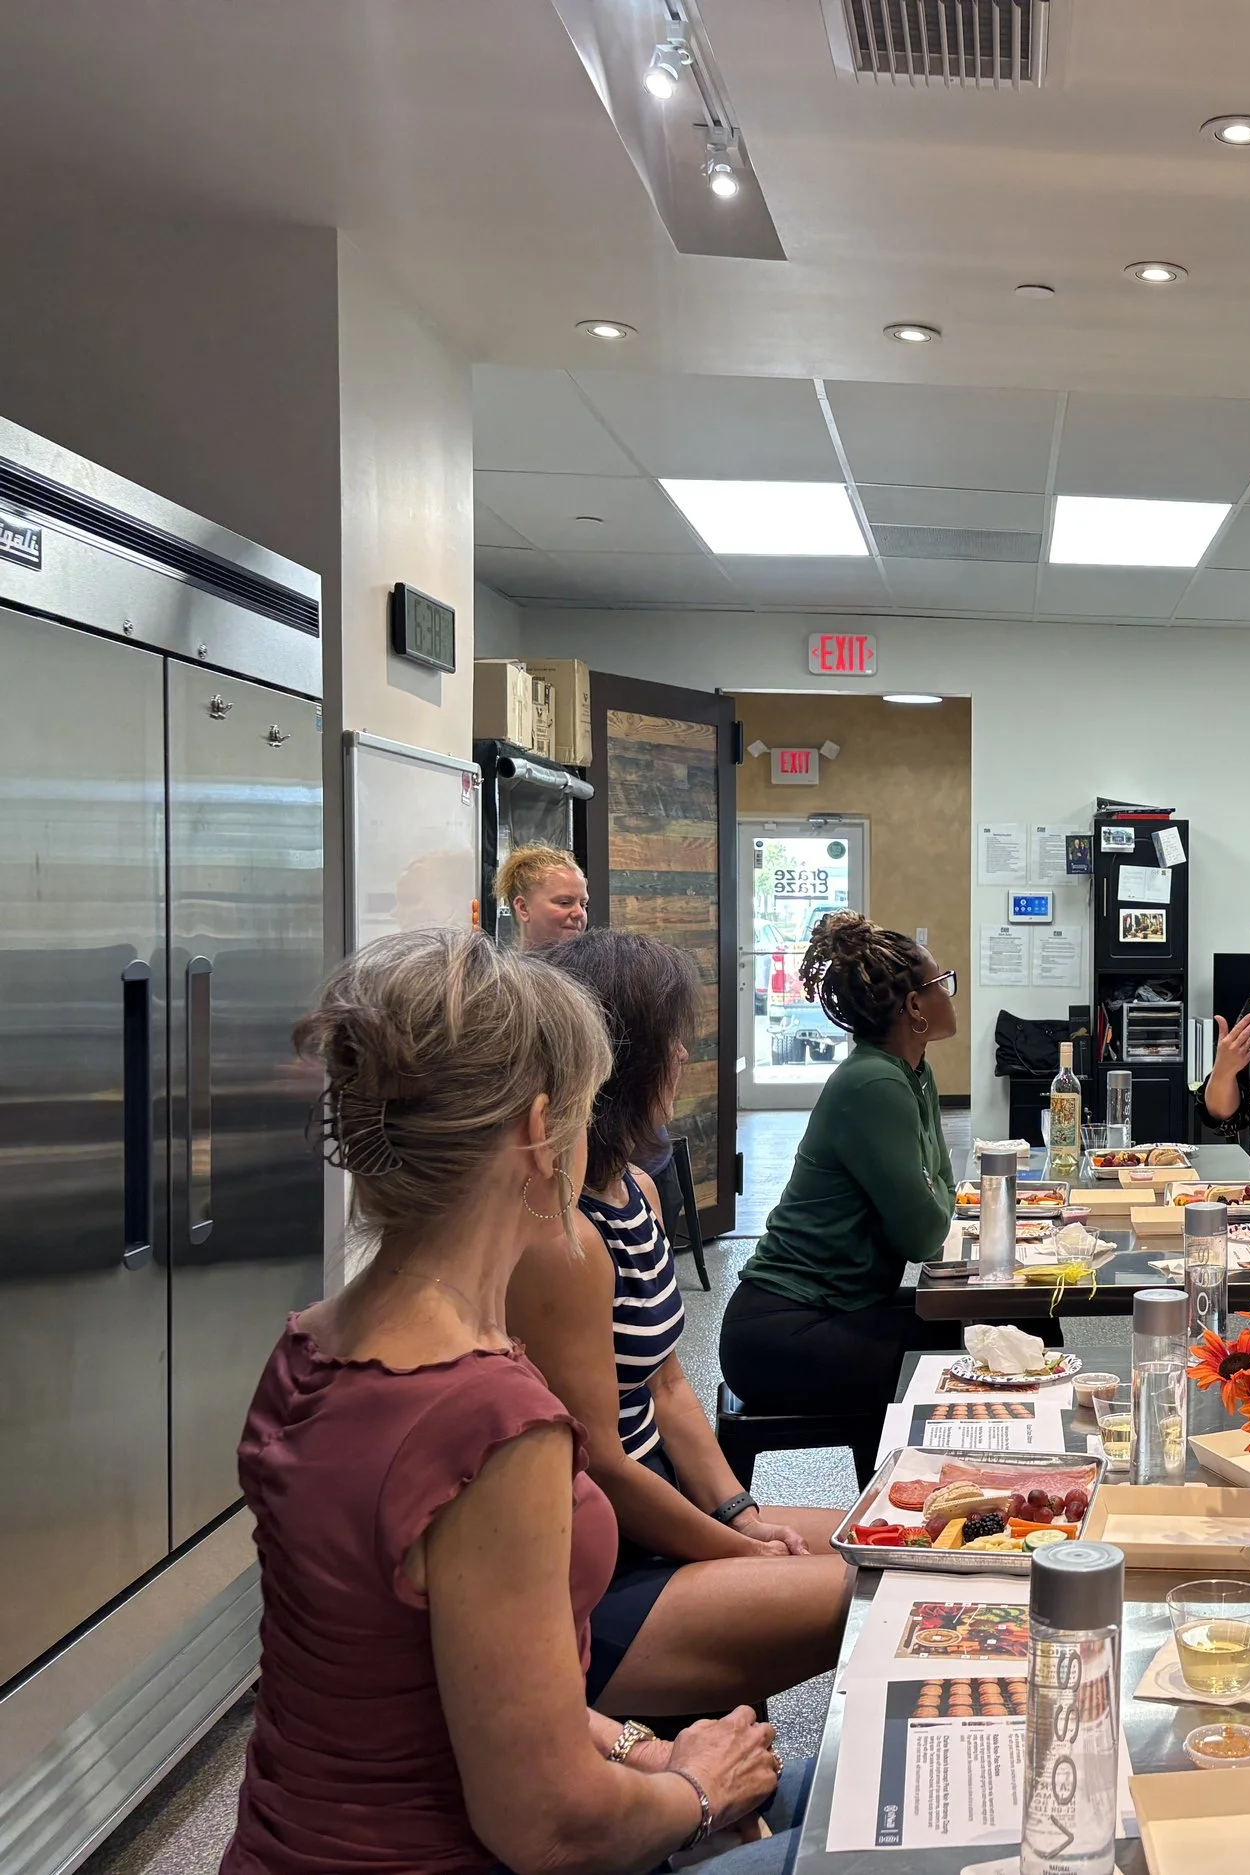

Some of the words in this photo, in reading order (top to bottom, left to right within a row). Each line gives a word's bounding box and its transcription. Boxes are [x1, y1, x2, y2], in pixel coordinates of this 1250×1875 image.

[820, 636, 867, 672] EXIT
[780, 751, 810, 774] EXIT
[1044, 1651, 1082, 1859] VOSS
